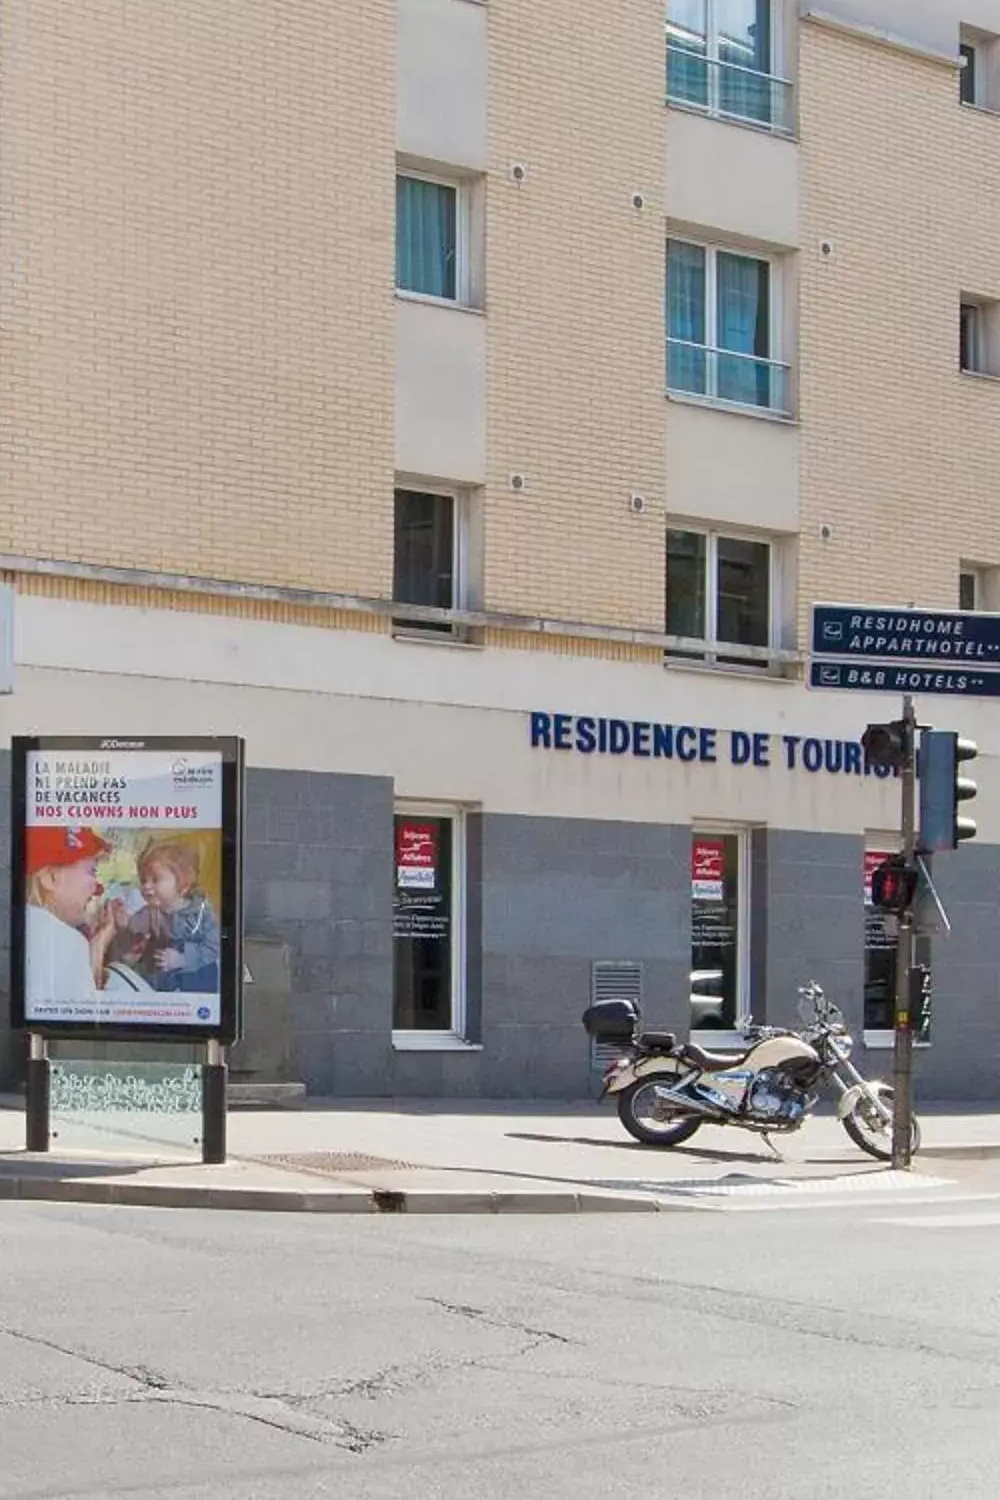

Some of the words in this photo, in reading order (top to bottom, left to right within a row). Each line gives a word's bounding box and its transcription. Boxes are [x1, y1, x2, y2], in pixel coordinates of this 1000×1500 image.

[851, 615, 965, 635] RESIDHOME
[847, 669, 886, 685] B&B
[895, 673, 968, 689] HOTELS
[530, 711, 717, 763] RESIDENCE
[730, 730, 770, 767] DE
[35, 761, 50, 774] LA
[55, 761, 110, 774] MALADIE
[56, 776, 98, 789] PREND
[103, 776, 127, 789] PAS
[35, 791, 51, 803] DE
[55, 791, 121, 804] VACANCES
[35, 805, 62, 818] NOS
[67, 805, 124, 819] CLOWNS
[129, 805, 159, 818] NON
[165, 806, 198, 819] PLUS
